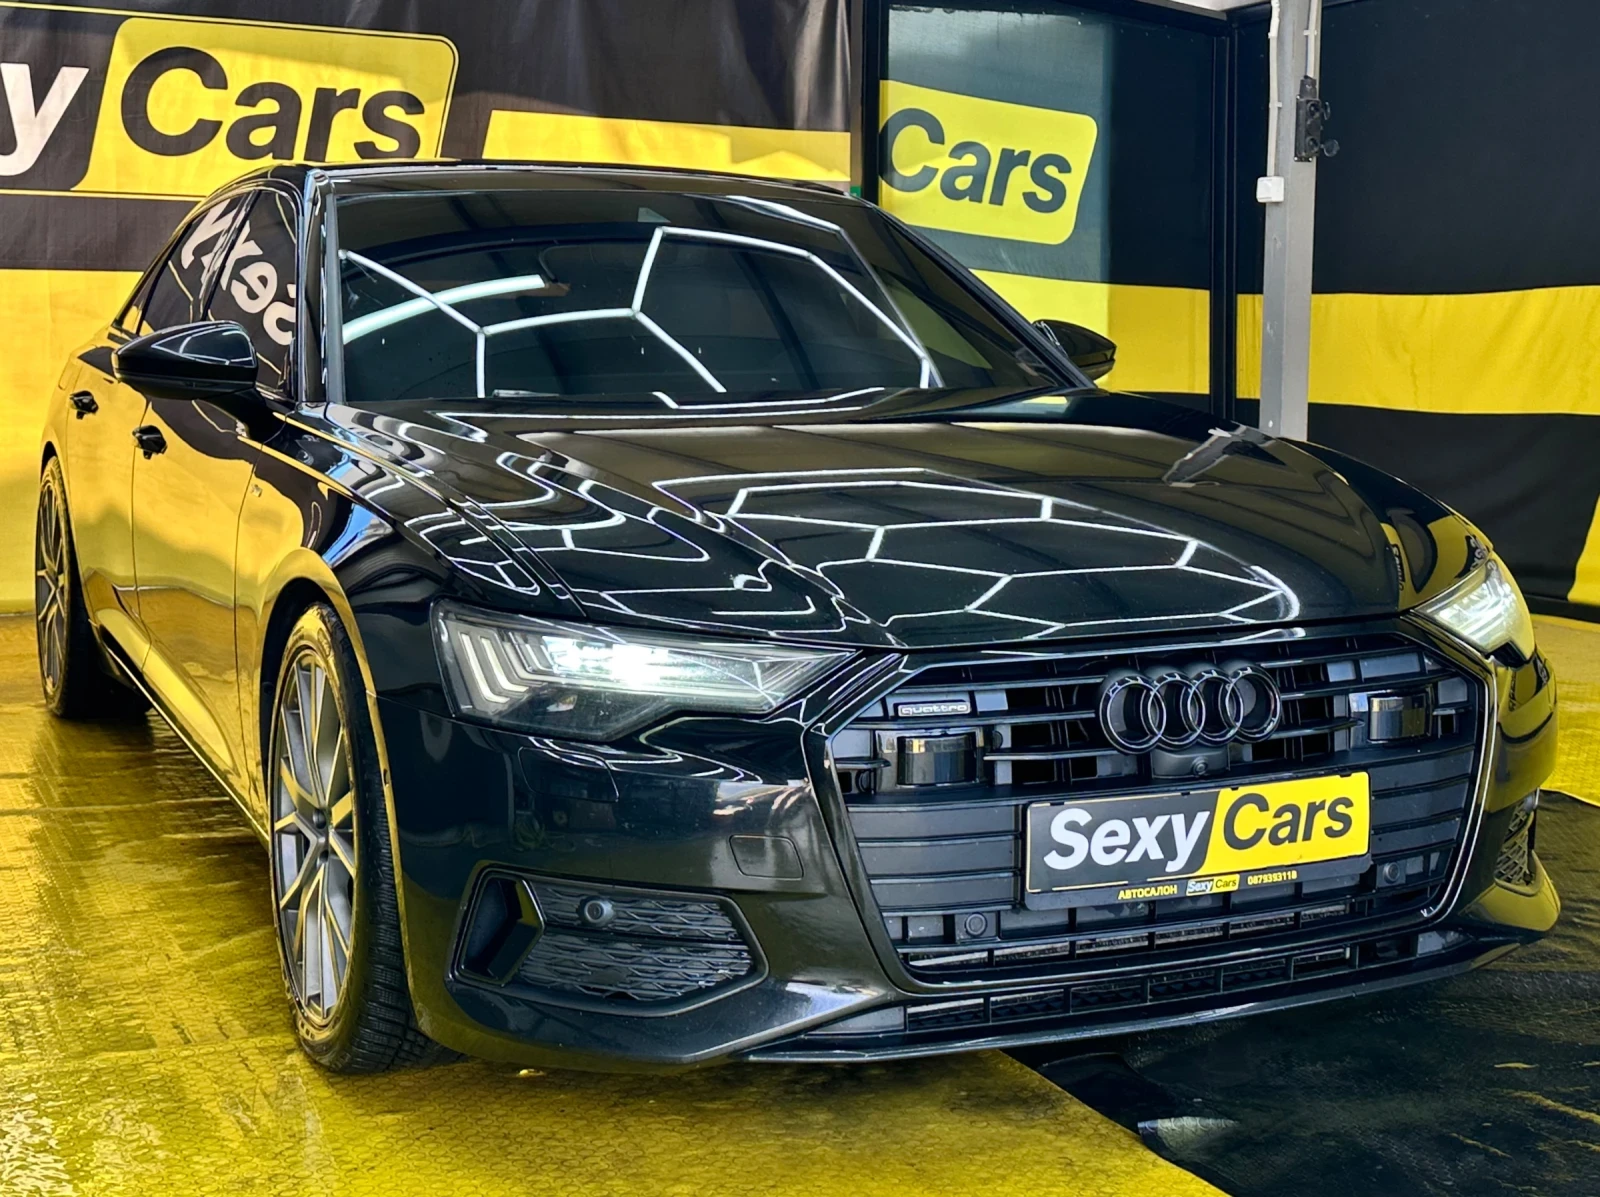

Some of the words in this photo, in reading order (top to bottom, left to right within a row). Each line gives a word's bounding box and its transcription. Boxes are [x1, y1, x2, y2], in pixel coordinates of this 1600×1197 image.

[121, 46, 425, 161] Cars
[878, 108, 1072, 214] Cars
[901, 704, 967, 715] quattro
[1043, 807, 1210, 873] Sexy
[1223, 792, 1354, 851] Cars
[1118, 884, 1178, 900] АВТОСАЛОН
[1187, 879, 1214, 893] Sexy
[1215, 879, 1237, 889] Cars
